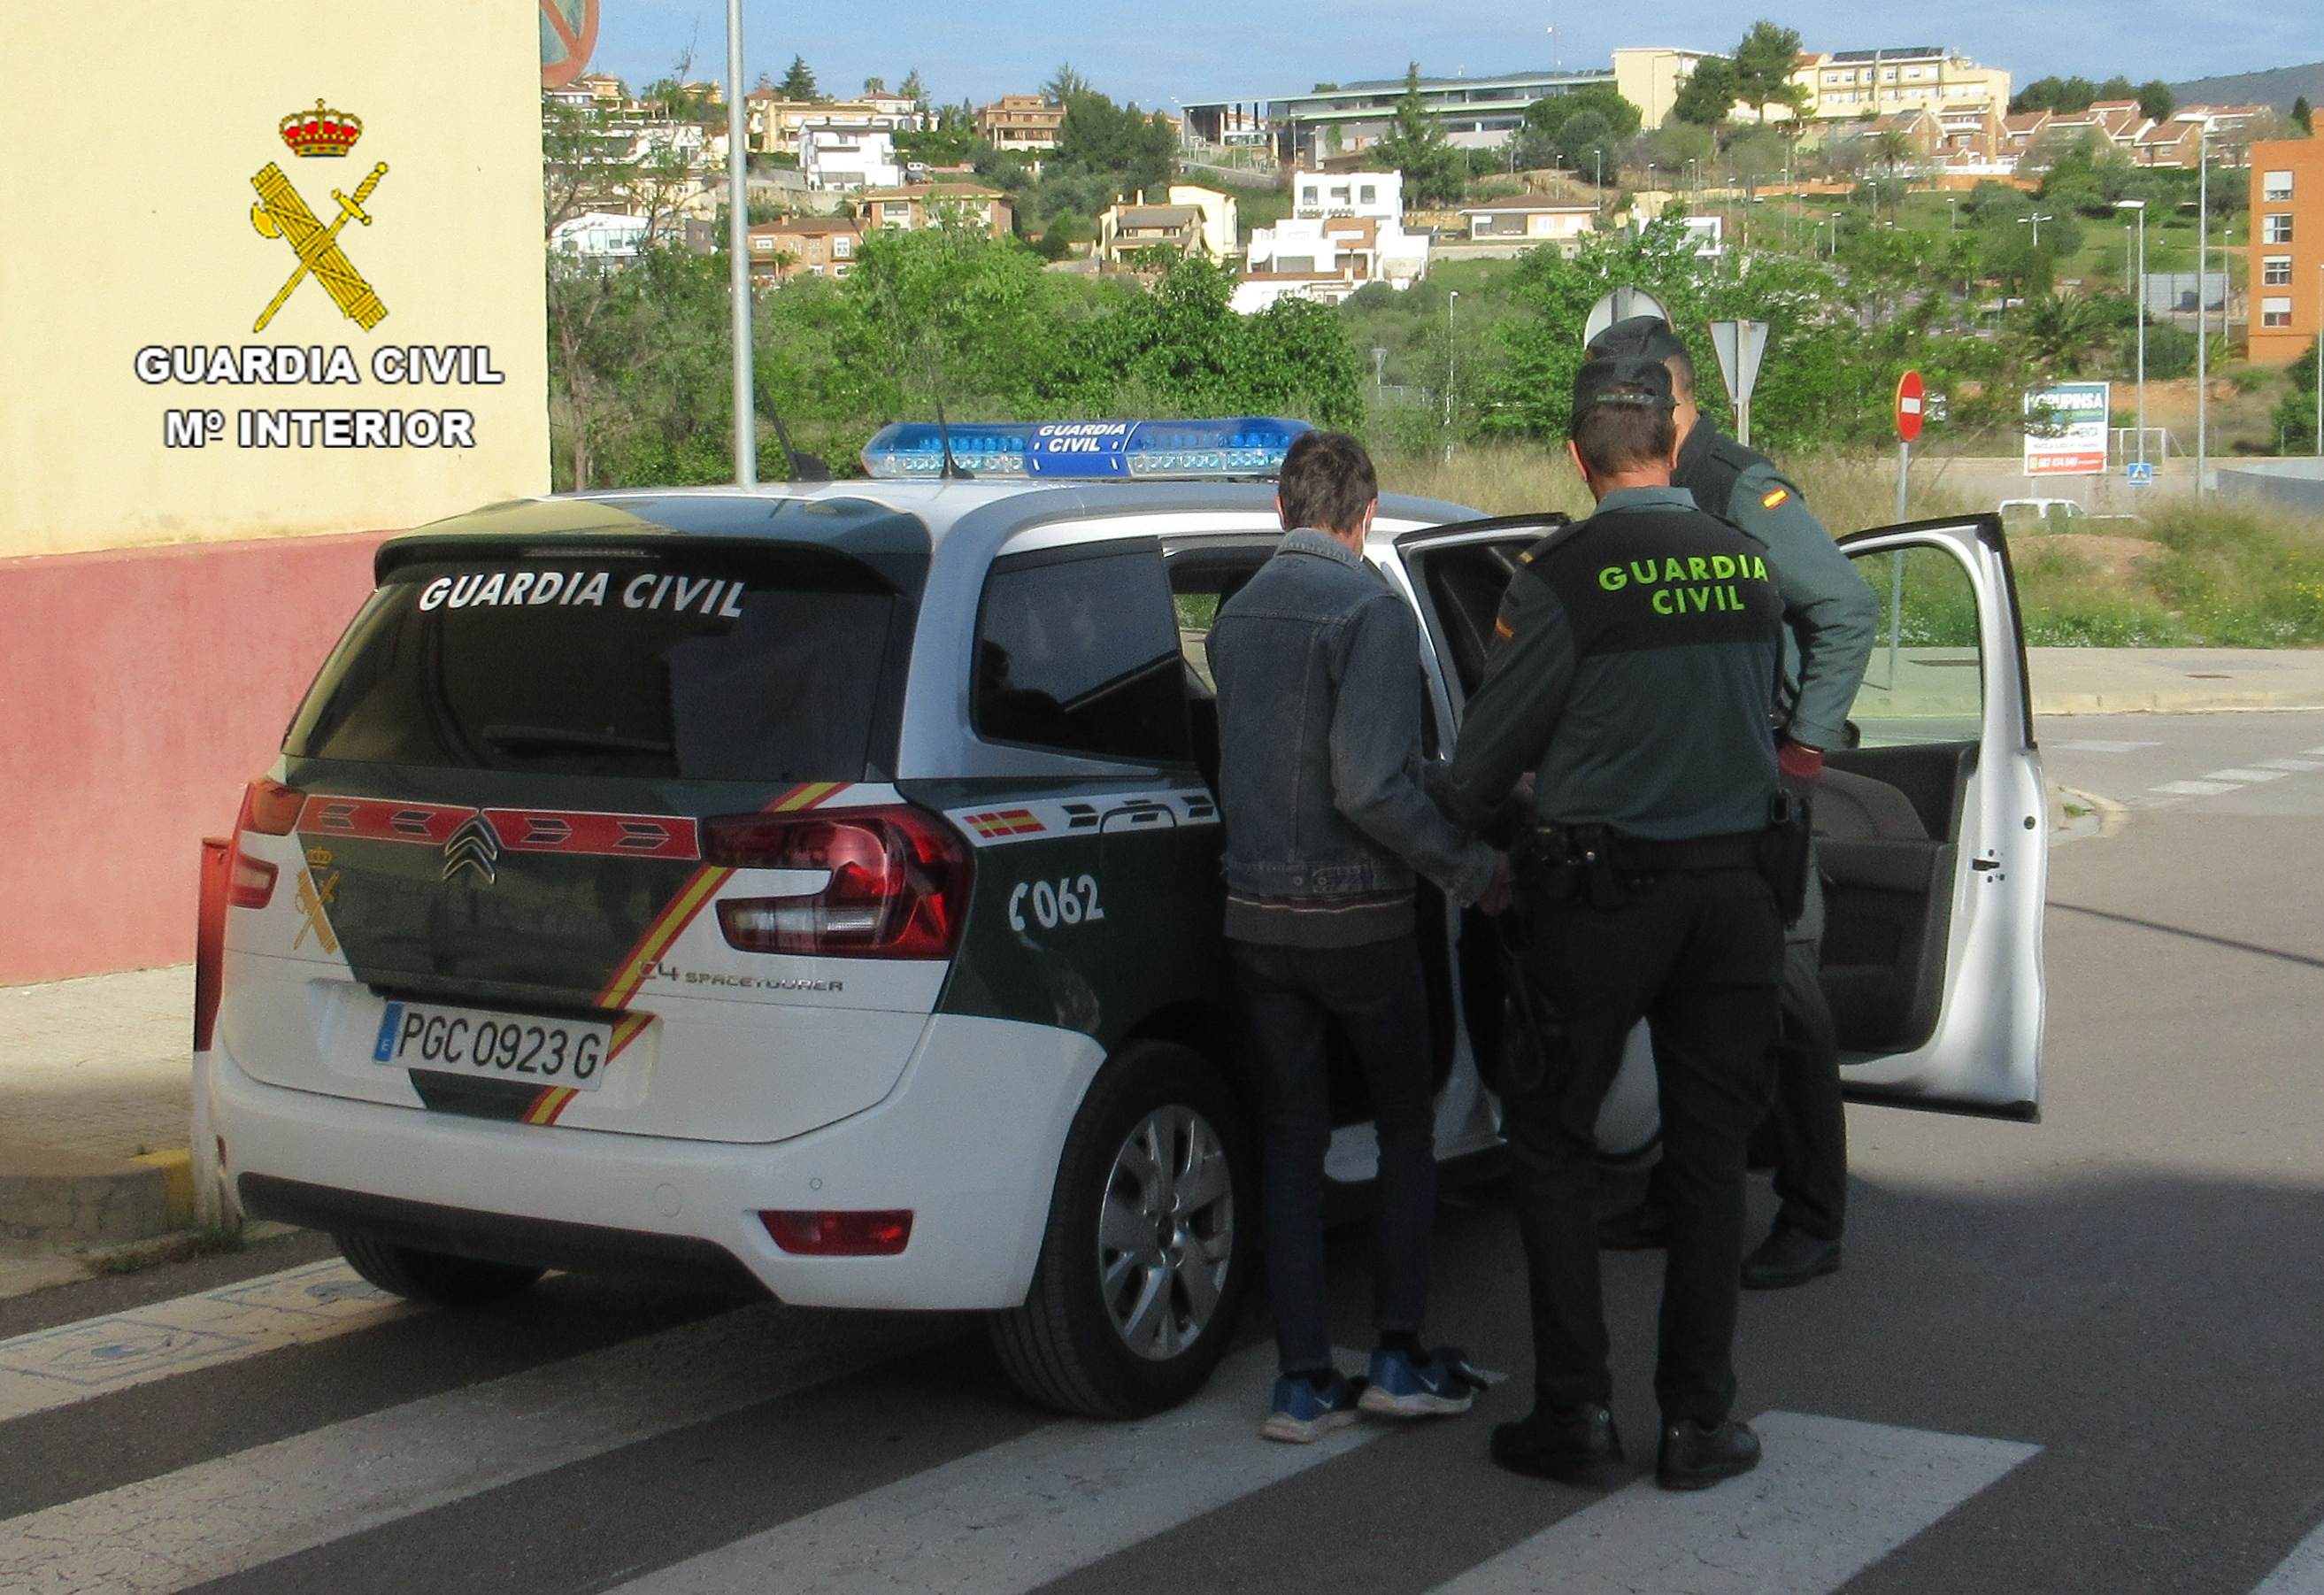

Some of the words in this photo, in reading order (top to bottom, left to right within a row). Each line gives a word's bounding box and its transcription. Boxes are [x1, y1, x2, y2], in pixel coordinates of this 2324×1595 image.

[1039, 424, 1127, 436] GUARDIA
[1049, 437, 1101, 452] CIVIL
[1598, 554, 1769, 591] GUARDIA
[419, 571, 611, 611] GUARDIA
[623, 574, 745, 618] CIVIL
[1651, 585, 1745, 614] CIVIL
[640, 959, 679, 982] C4
[685, 971, 844, 992] SPACETOURER
[397, 1012, 469, 1062] PGC
[473, 1021, 569, 1075] 0923
[573, 1032, 601, 1080] G
